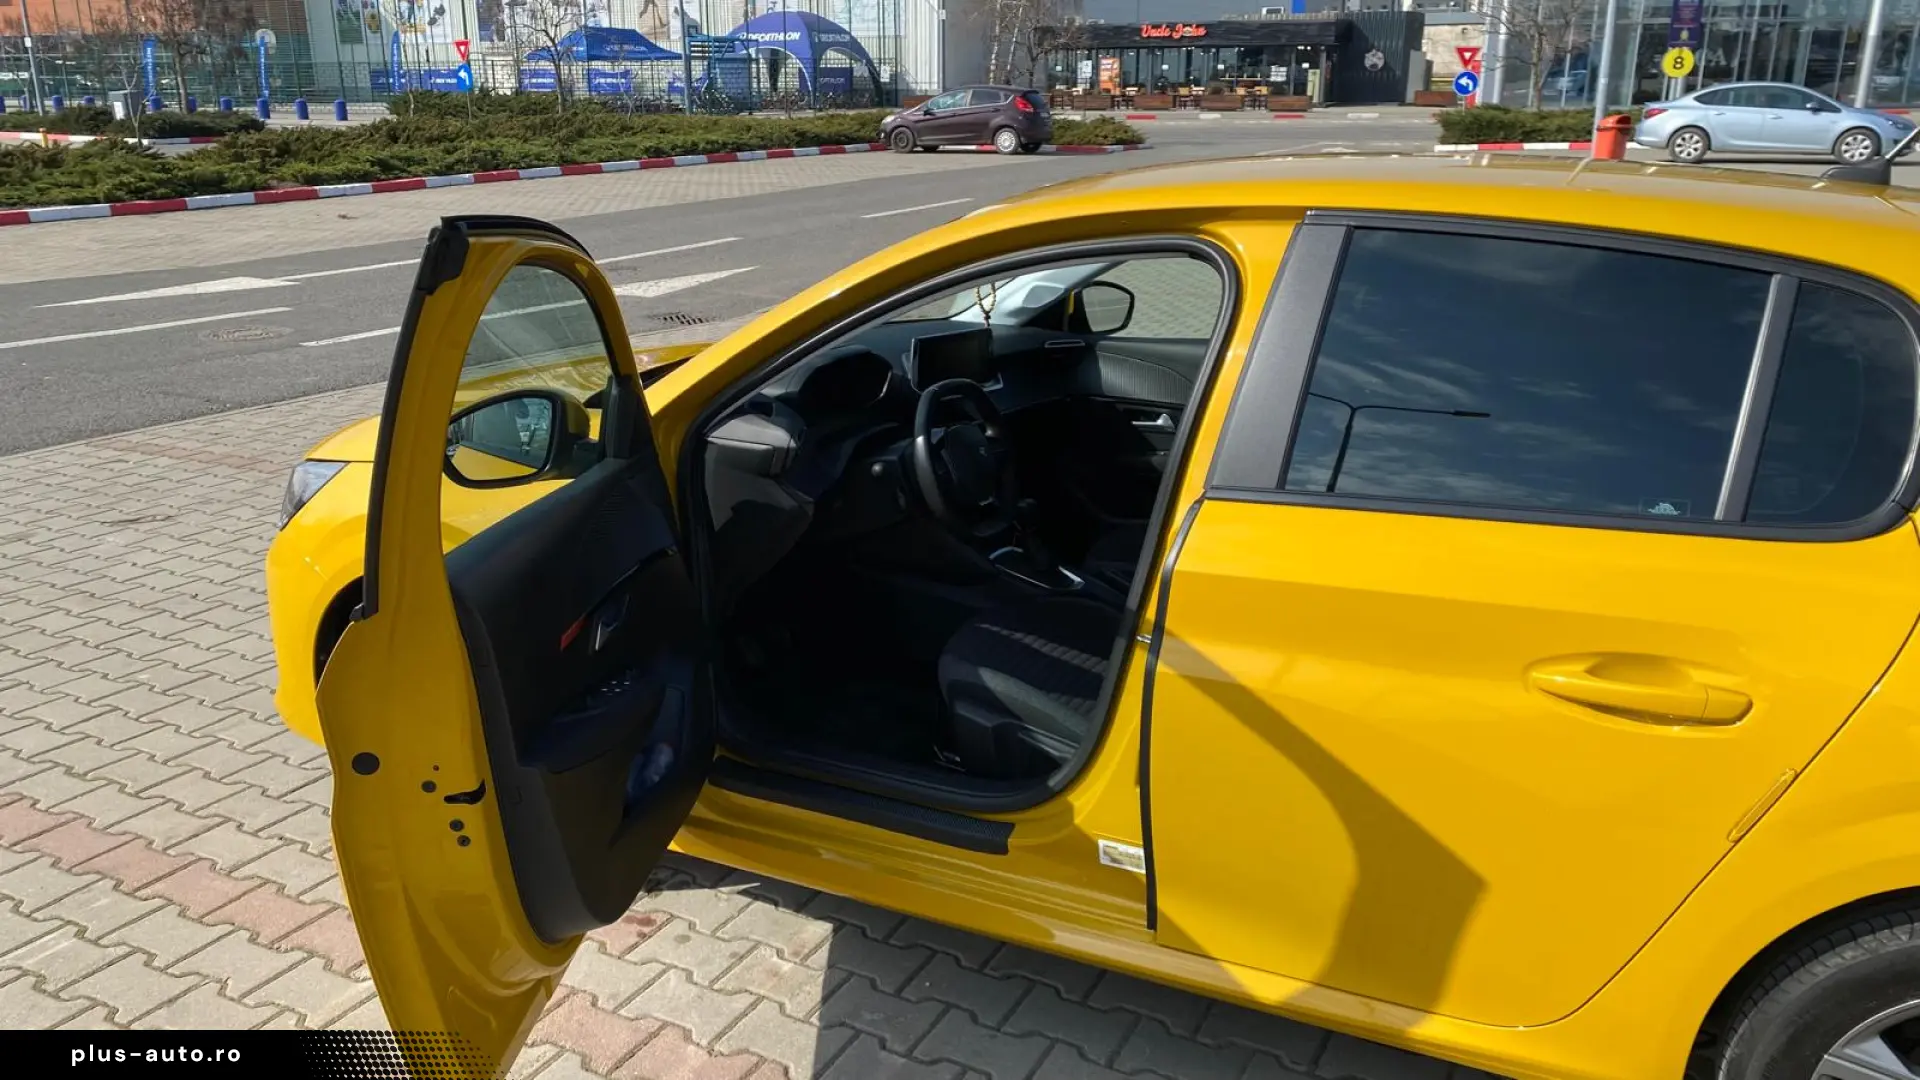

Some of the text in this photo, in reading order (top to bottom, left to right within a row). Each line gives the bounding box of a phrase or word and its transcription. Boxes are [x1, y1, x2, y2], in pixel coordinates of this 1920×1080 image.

[747, 31, 801, 41] DECATHLON
[1141, 23, 1207, 39] Uncle John
[1673, 56, 1684, 70] 8
